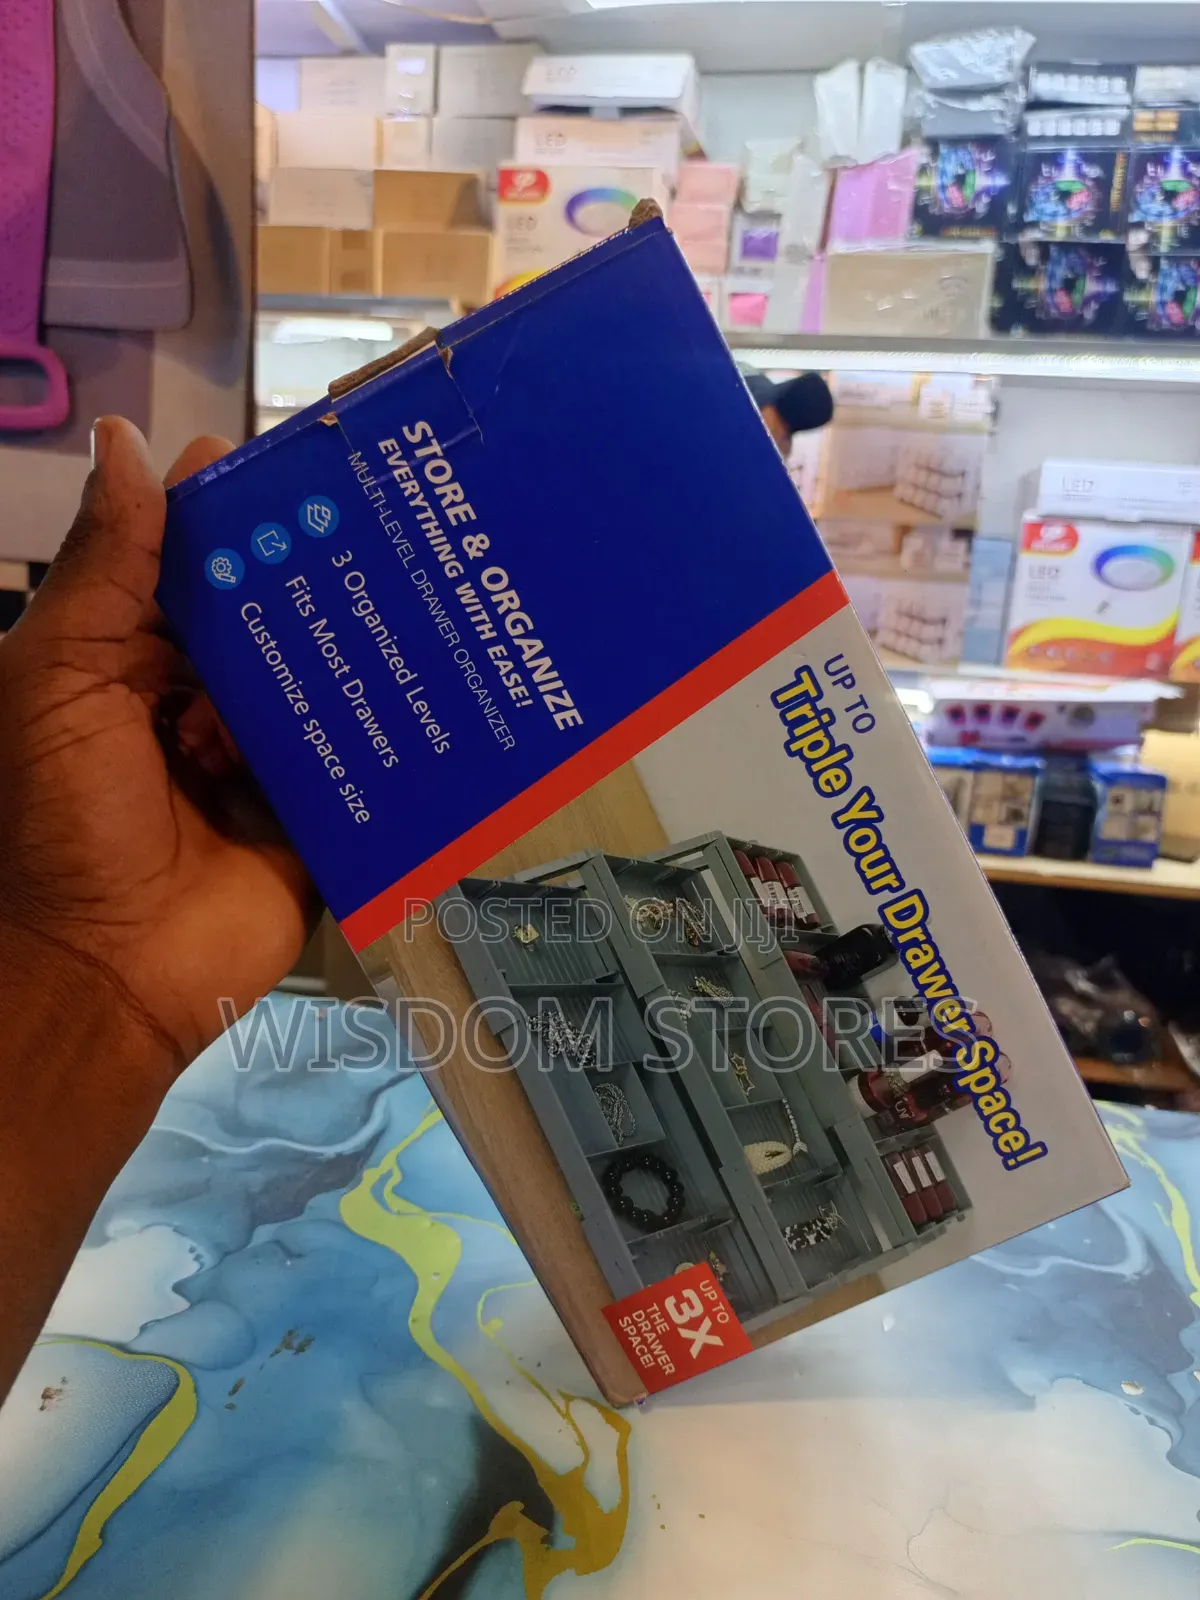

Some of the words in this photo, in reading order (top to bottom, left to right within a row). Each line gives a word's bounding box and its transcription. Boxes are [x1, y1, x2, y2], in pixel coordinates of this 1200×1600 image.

[332, 550, 352, 567] 3
[344, 570, 418, 685] Organized
[406, 685, 450, 754] Levels
[348, 451, 420, 569] MULTI-LEVEL
[410, 569, 460, 648] DRAWER
[453, 641, 515, 751] ORGANIZER
[378, 438, 464, 579] EVERYTHING
[455, 581, 498, 640] WITH
[487, 638, 534, 707] EASE!
[403, 420, 476, 526] STORE
[462, 533, 490, 559] &
[481, 567, 584, 731] ORGANIZE
[240, 602, 309, 715] Customize
[303, 718, 345, 779] space
[339, 782, 370, 824] size
[285, 575, 315, 617] Fits
[309, 618, 351, 678] Most
[342, 678, 398, 768] Drawers
[824, 652, 856, 691] UP
[844, 694, 876, 734] TO
[770, 665, 853, 798] Triple
[831, 786, 907, 896] Your
[880, 888, 976, 1041] Drawer
[954, 1036, 1048, 1170] Space!
[619, 1316, 656, 1368] SPACE!
[632, 1310, 676, 1375] DRAWER
[646, 1303, 670, 1335] THE
[665, 1289, 724, 1360] 3X
[700, 1280, 718, 1301] UP
[712, 1302, 729, 1324] TO
